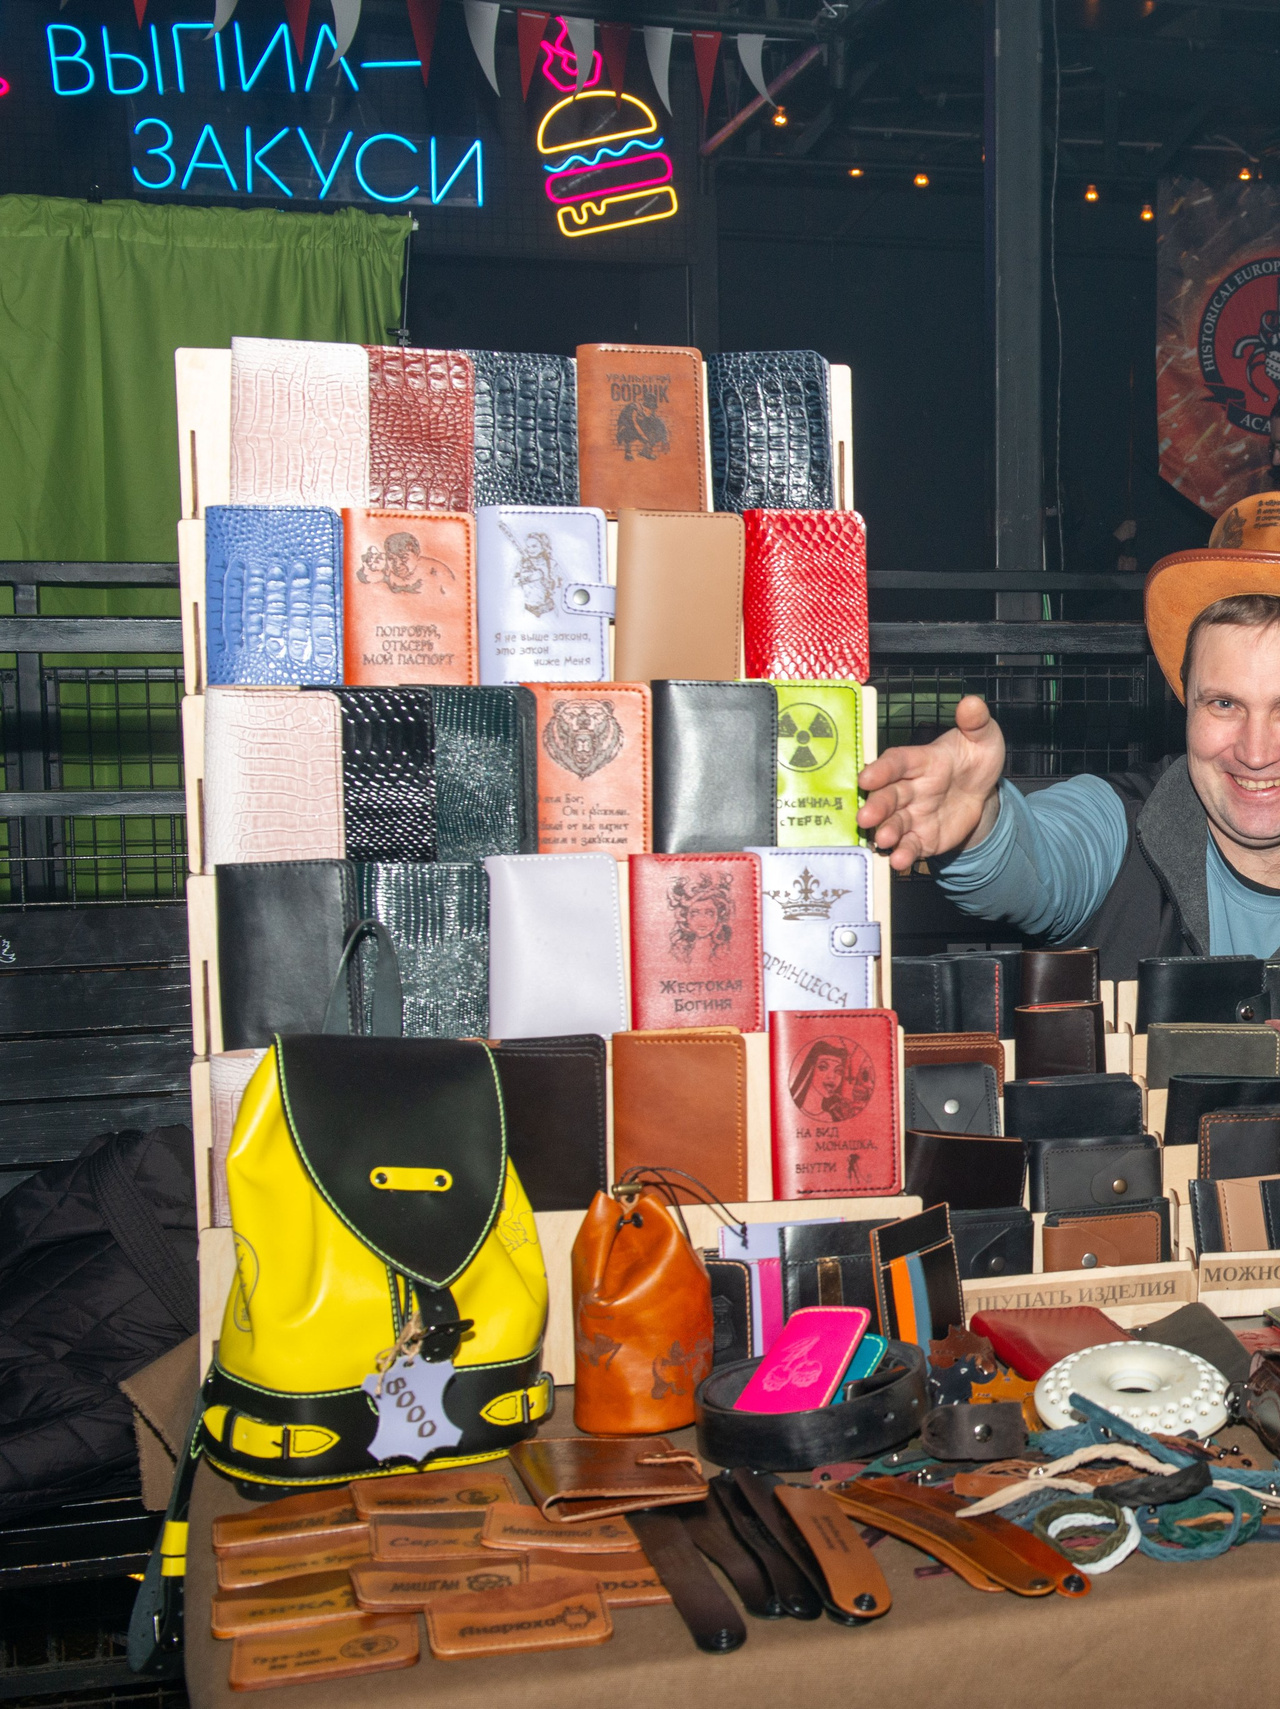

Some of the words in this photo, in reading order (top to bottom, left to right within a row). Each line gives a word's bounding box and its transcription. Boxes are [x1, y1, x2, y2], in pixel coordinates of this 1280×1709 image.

[132, 117, 484, 207] ЗАКУСИ
[1201, 282, 1236, 372] HISTORICAL
[494, 632, 502, 643] Я
[520, 632, 550, 642] выше
[495, 647, 516, 656] это
[519, 646, 549, 655] закон
[362, 652, 393, 666] МОЙ
[397, 653, 455, 666] ПАСПОРТ
[776, 796, 843, 810] ОКСИЧНАЯ
[660, 980, 743, 994] ЖЕСТОКАЯ
[674, 999, 732, 1012] БОГИНЯ
[796, 1129, 811, 1138] НА
[815, 1127, 839, 1138] ВИД
[1079, 1279, 1177, 1304] ИЗДЕЛИЯ
[386, 1377, 437, 1438] 8000
